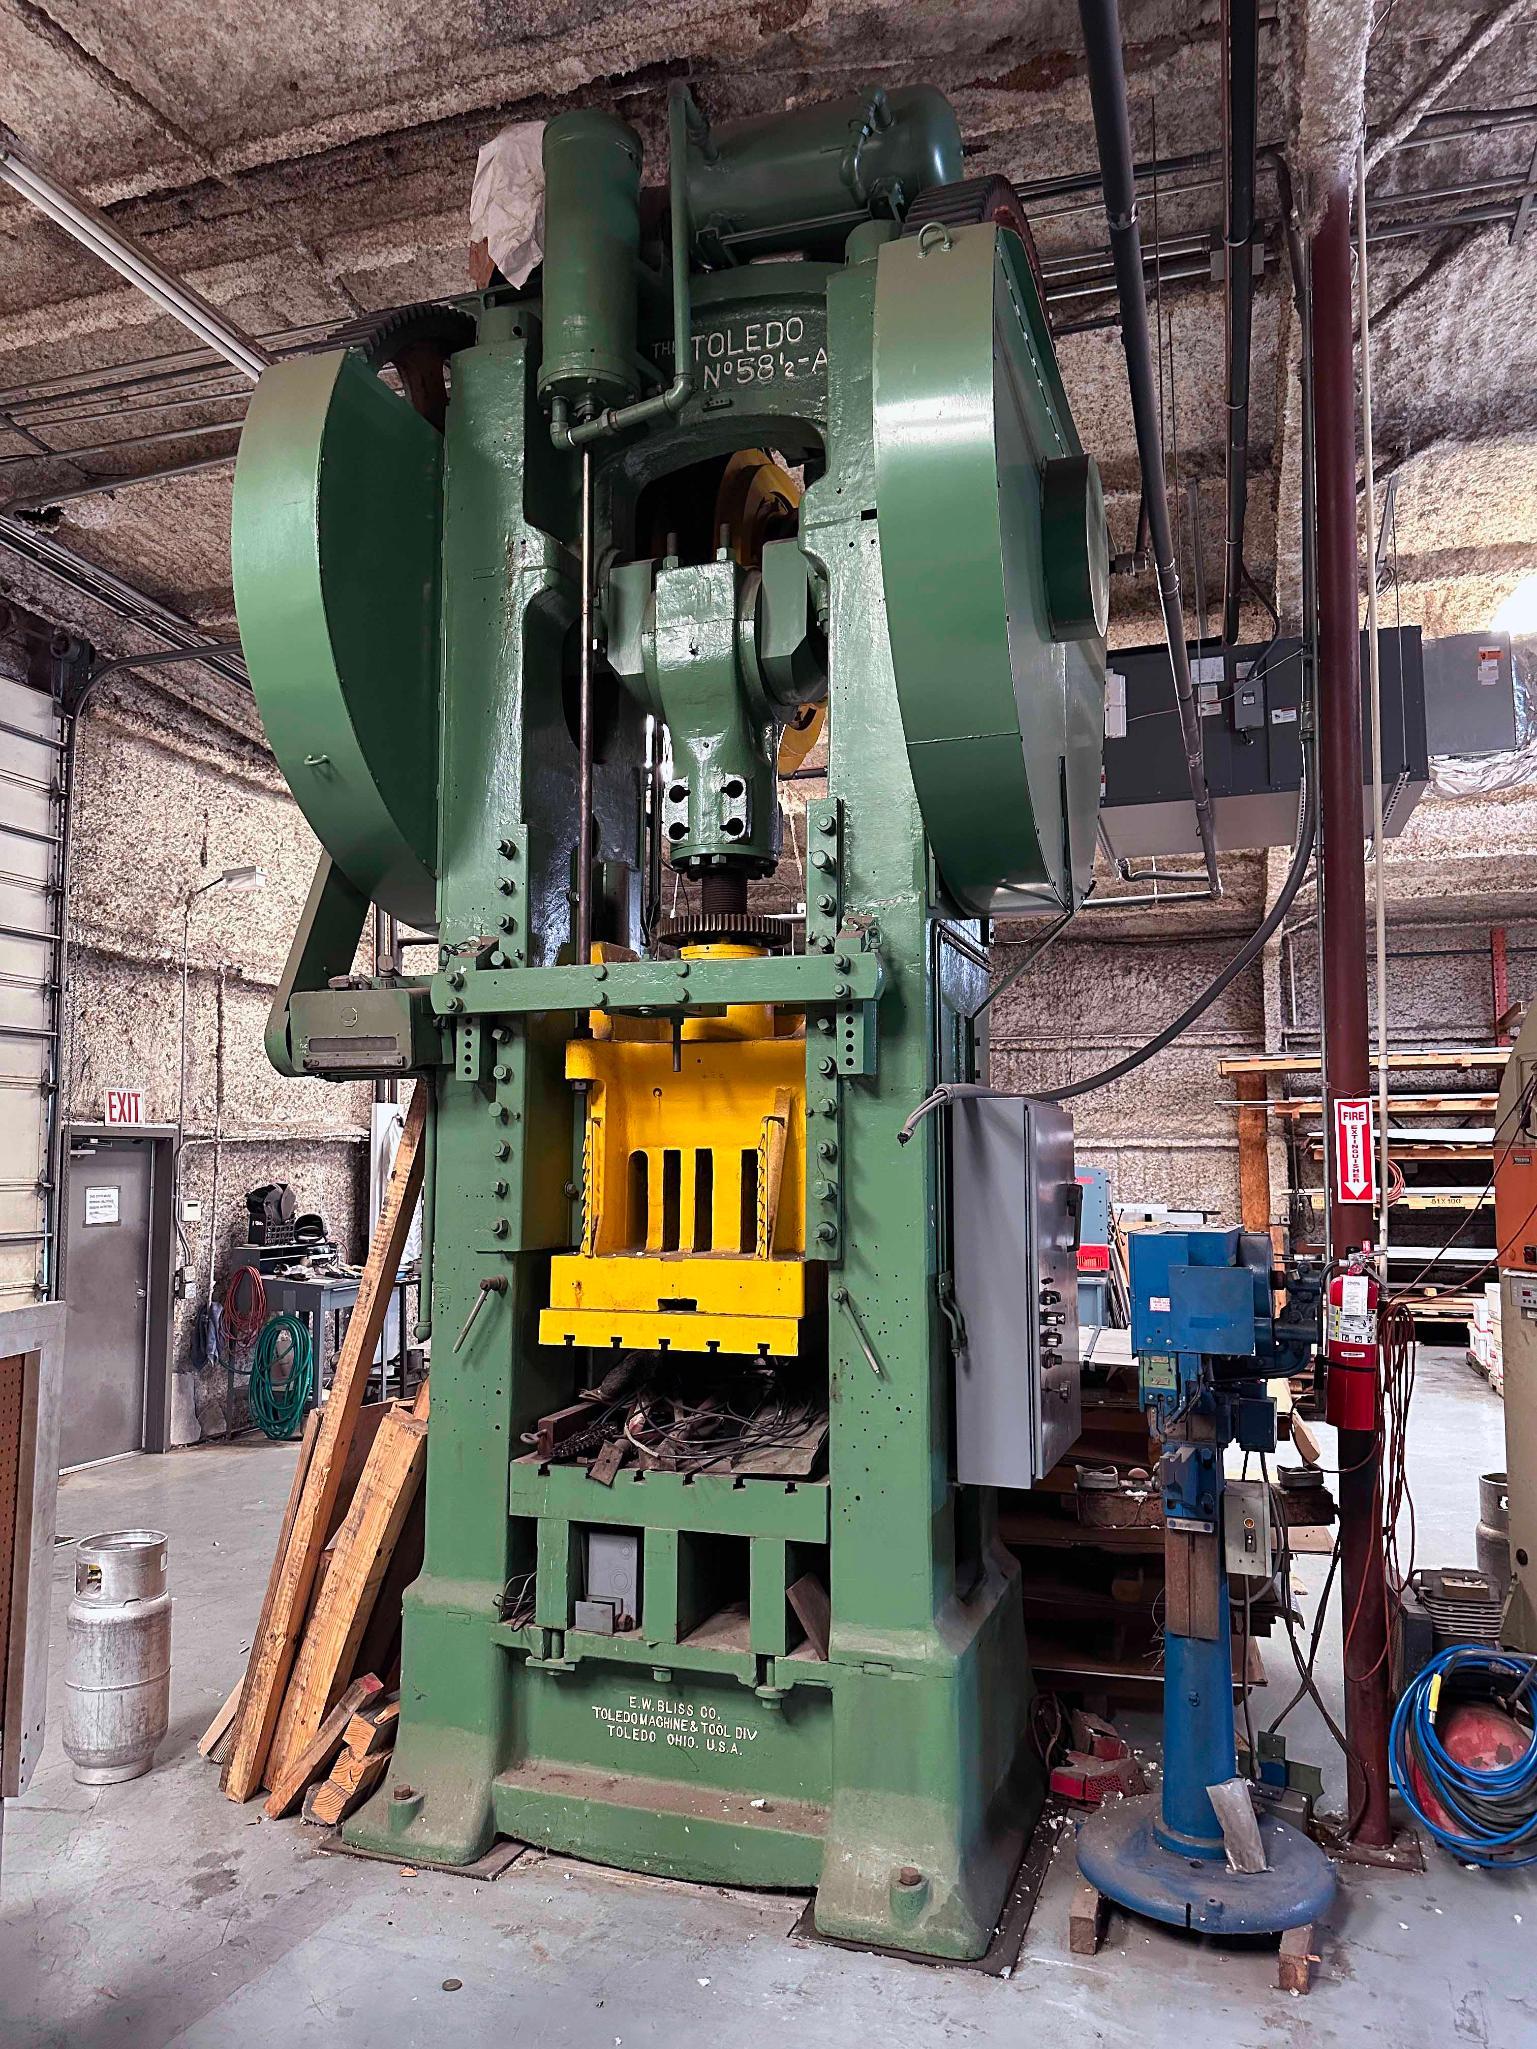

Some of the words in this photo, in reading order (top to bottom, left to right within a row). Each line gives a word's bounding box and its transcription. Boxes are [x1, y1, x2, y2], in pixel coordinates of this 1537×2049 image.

[691, 317, 804, 361] TOLEDO
[108, 1091, 141, 1123] EXIT
[1343, 1111, 1365, 1121] FIRE
[1350, 1124, 1360, 1183] EXTINGUISHER
[591, 1706, 638, 1725] TOLEDO
[640, 1713, 688, 1732] MACHINE
[690, 1720, 699, 1733] &
[700, 1721, 731, 1738] TOOL
[735, 1726, 758, 1741] DIV
[700, 1706, 721, 1721] CO.
[607, 1724, 656, 1743] TOLEDO
[666, 1733, 699, 1749] OHIO.
[706, 1738, 743, 1756] U.S.A.
